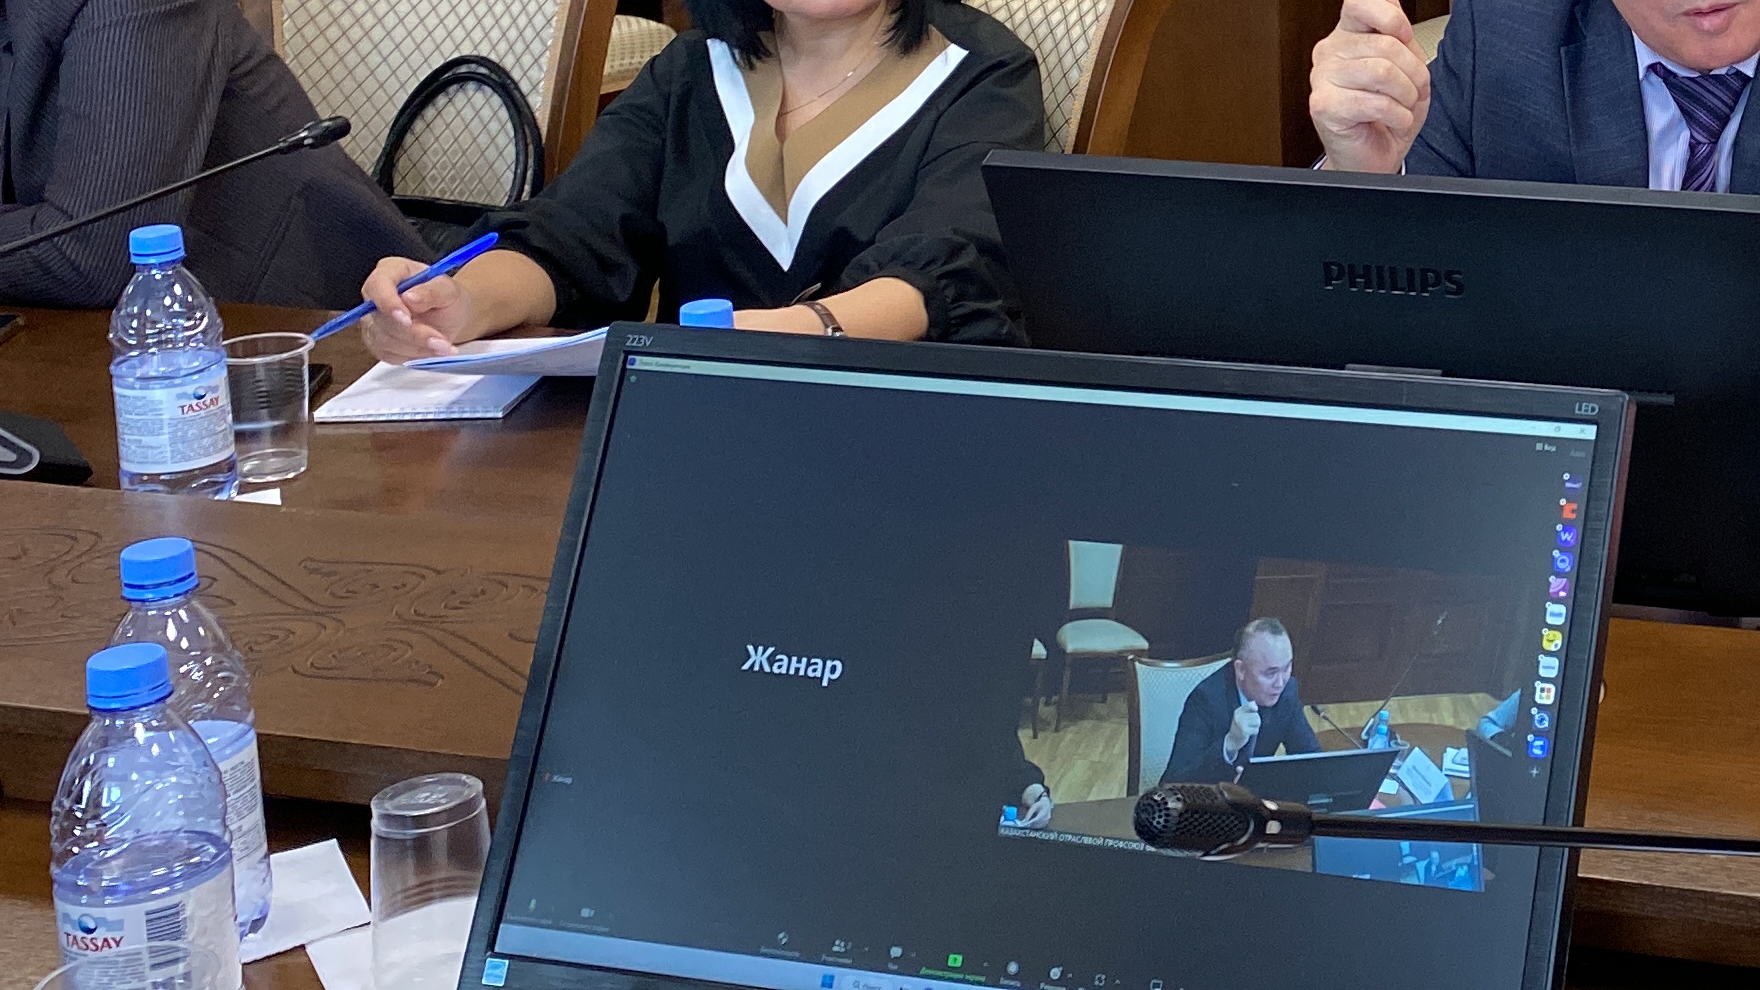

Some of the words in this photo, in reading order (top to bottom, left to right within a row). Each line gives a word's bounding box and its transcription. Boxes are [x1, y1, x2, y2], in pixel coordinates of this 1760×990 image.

[1323, 262, 1465, 299] PHILIPS
[625, 333, 654, 347] 223V
[177, 395, 220, 416] TASSAY
[1574, 401, 1599, 416] LED
[741, 644, 843, 687] Жанар
[1059, 832, 1104, 846] ОТРАСЛЕВОЙ
[64, 931, 125, 952] TASSAY
